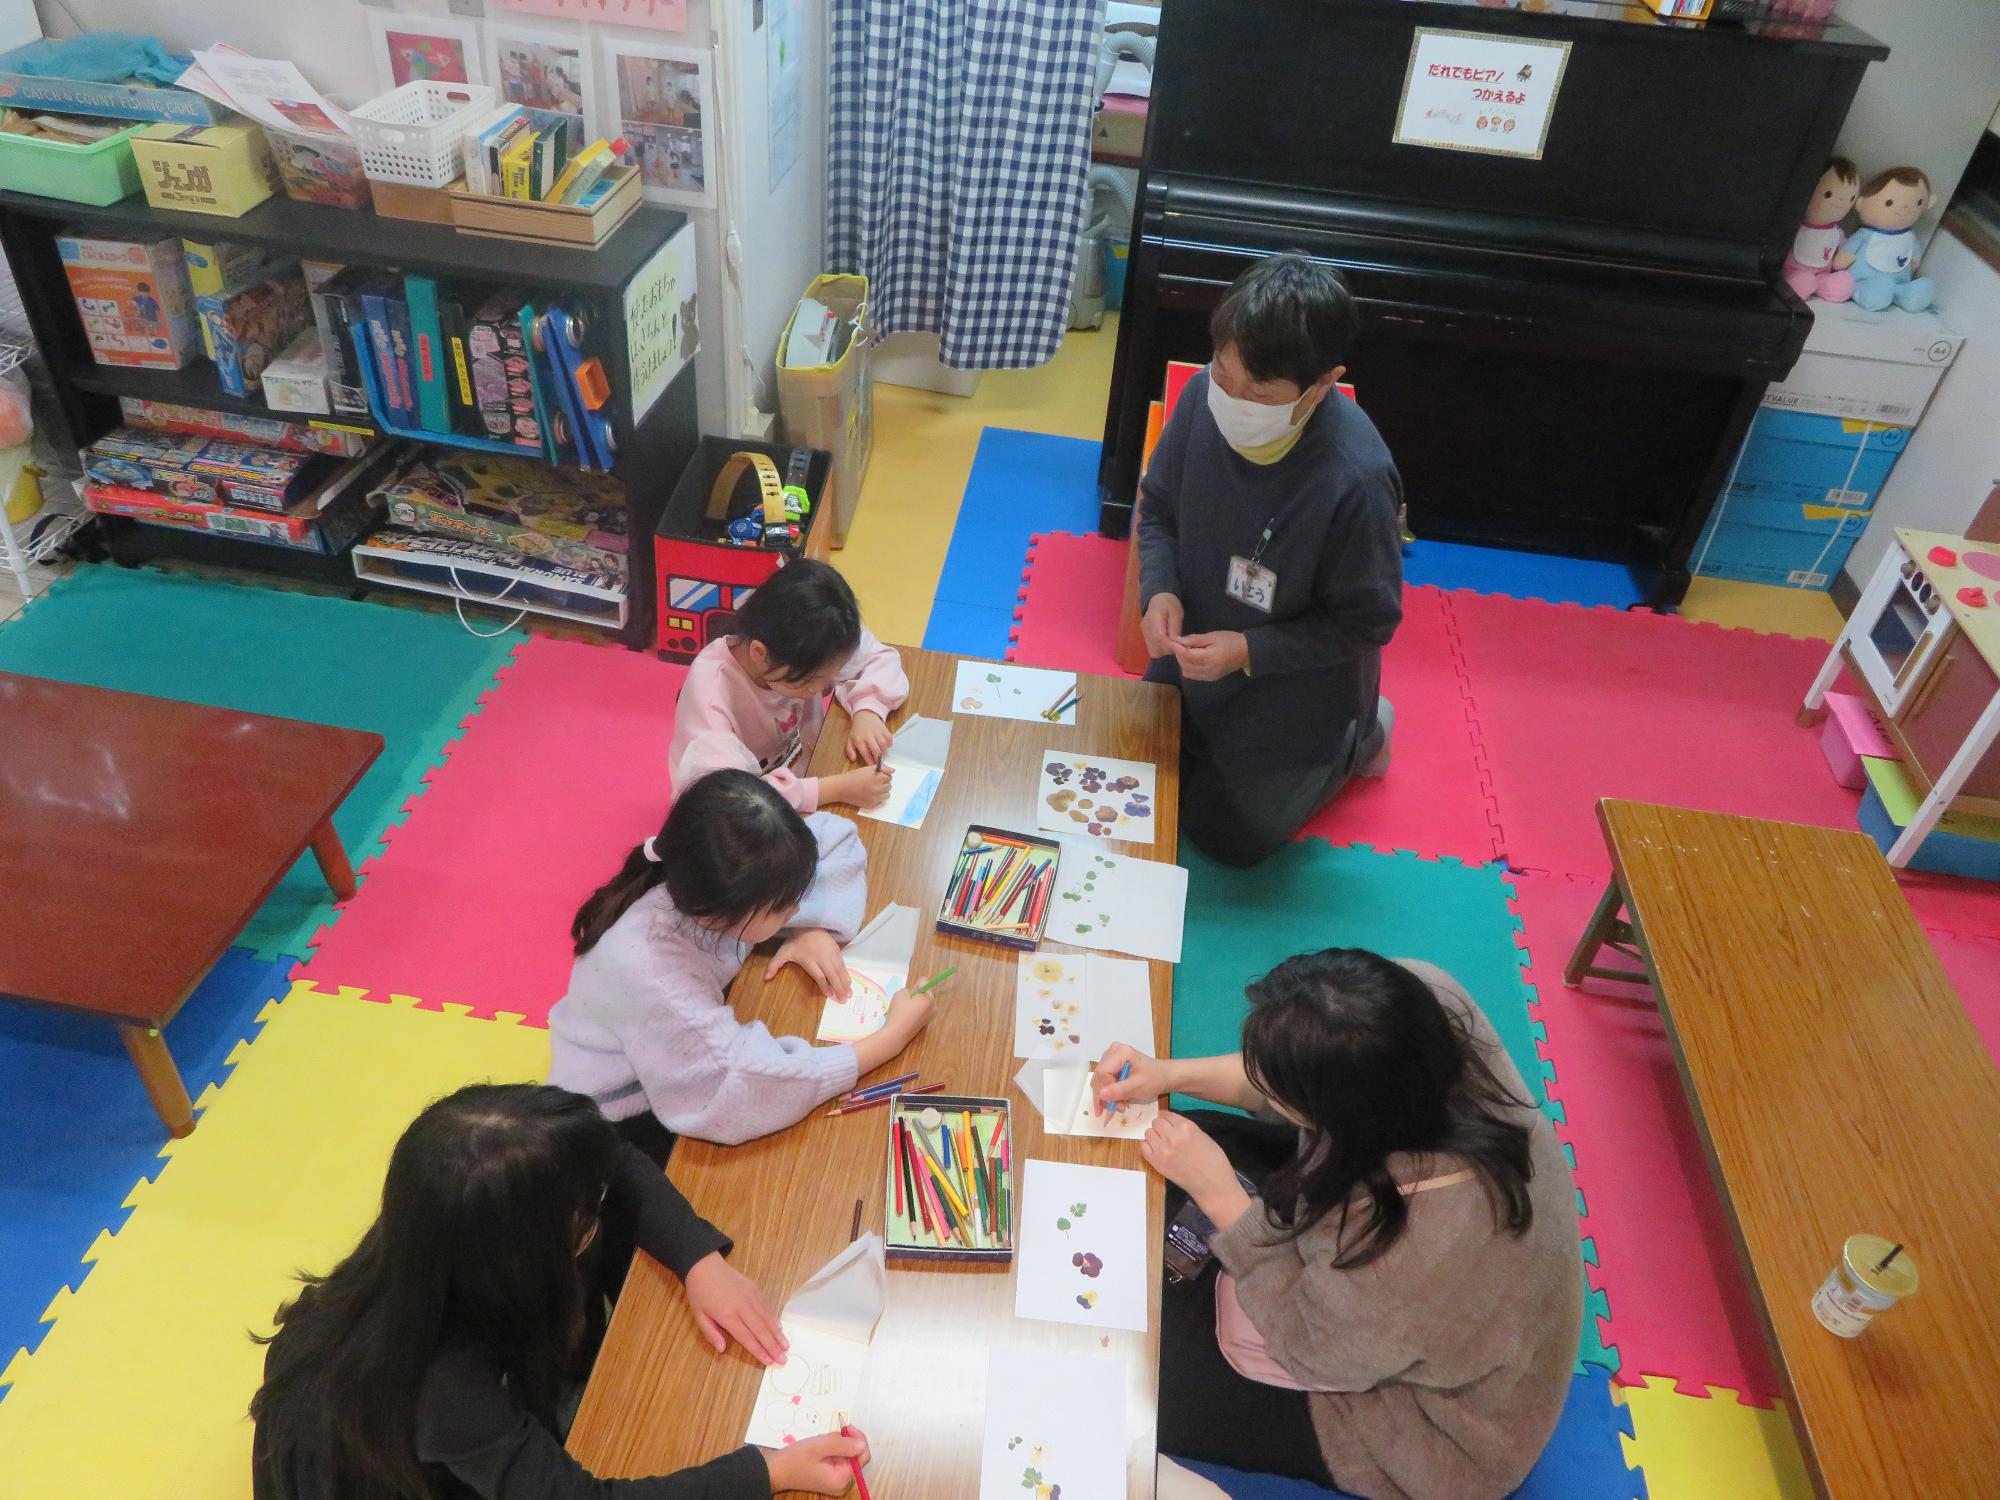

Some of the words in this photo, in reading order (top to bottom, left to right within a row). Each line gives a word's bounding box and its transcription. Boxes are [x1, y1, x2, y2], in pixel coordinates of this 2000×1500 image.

[1428, 63, 1505, 83] だれでもピアノ
[22, 86, 61, 102] CATCH
[76, 91, 115, 108] COUNT
[120, 95, 163, 114] FISHING
[166, 101, 199, 117] GAME
[1472, 88, 1526, 103] つかえるよ
[152, 160, 213, 193] ジェンガ
[1762, 393, 1800, 406] TVALUE
